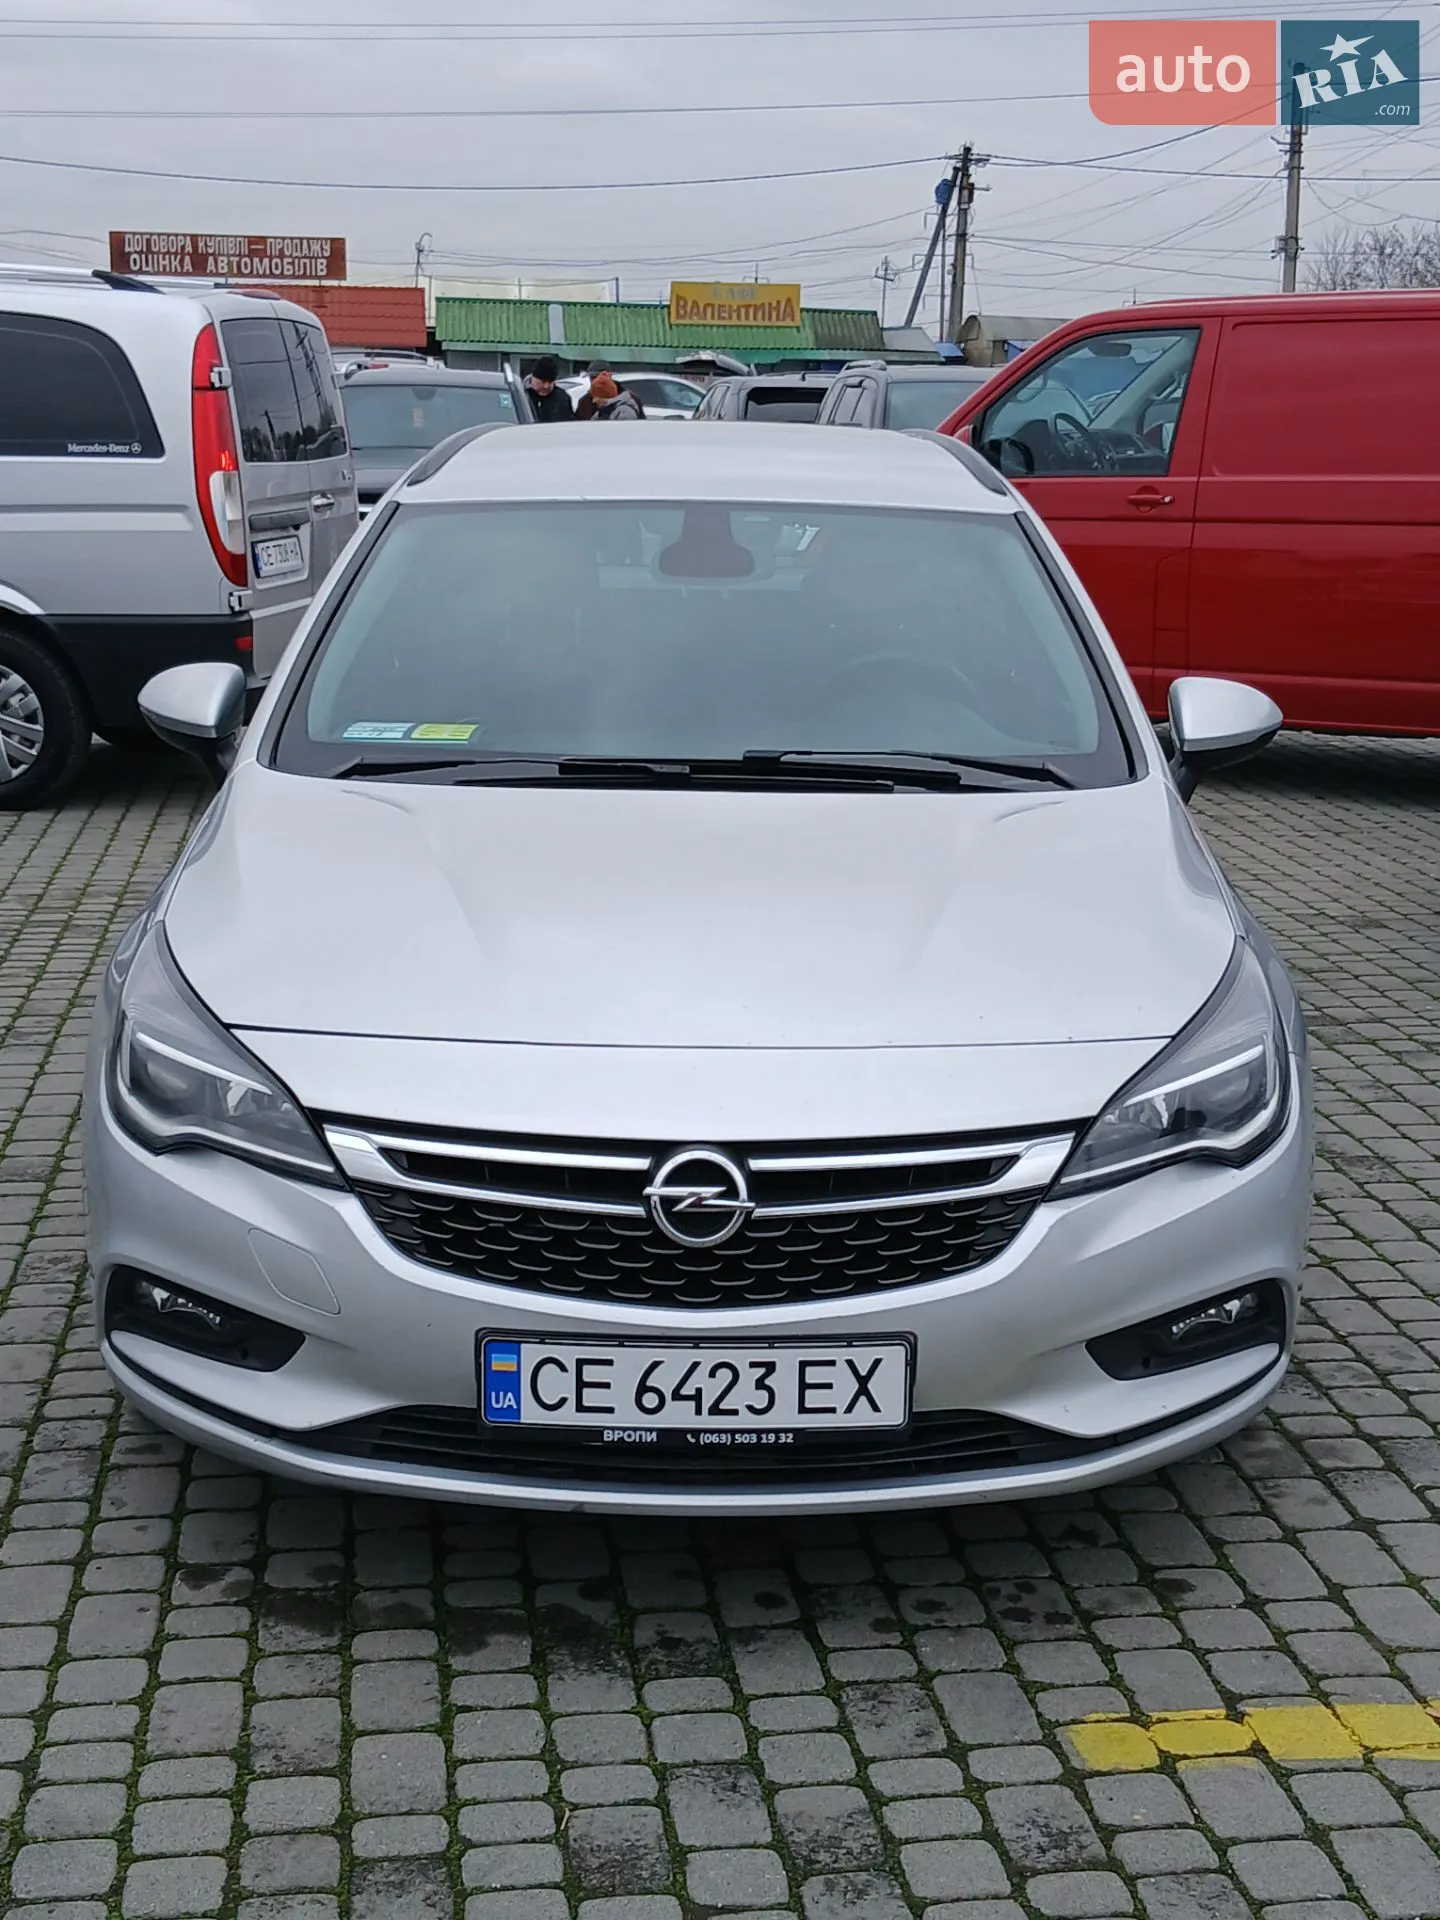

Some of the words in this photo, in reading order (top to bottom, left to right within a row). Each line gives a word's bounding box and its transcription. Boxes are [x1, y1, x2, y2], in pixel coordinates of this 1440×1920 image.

[124, 233, 192, 254] ДОГОВОРА
[129, 253, 193, 273] ОЦІНКА
[206, 257, 327, 276] АВТОМОБІЛІВ
[675, 294, 795, 322] ВАЛЕНТИНА
[67, 443, 130, 453] Mercedes-Benz
[529, 1355, 616, 1415] CE
[634, 1359, 777, 1417] 6423
[797, 1357, 884, 1414] EX
[490, 1391, 517, 1409] UA
[700, 1433, 732, 1445] (063)
[734, 1434, 757, 1443] 503
[760, 1433, 775, 1443] 19
[778, 1433, 794, 1443] 32
